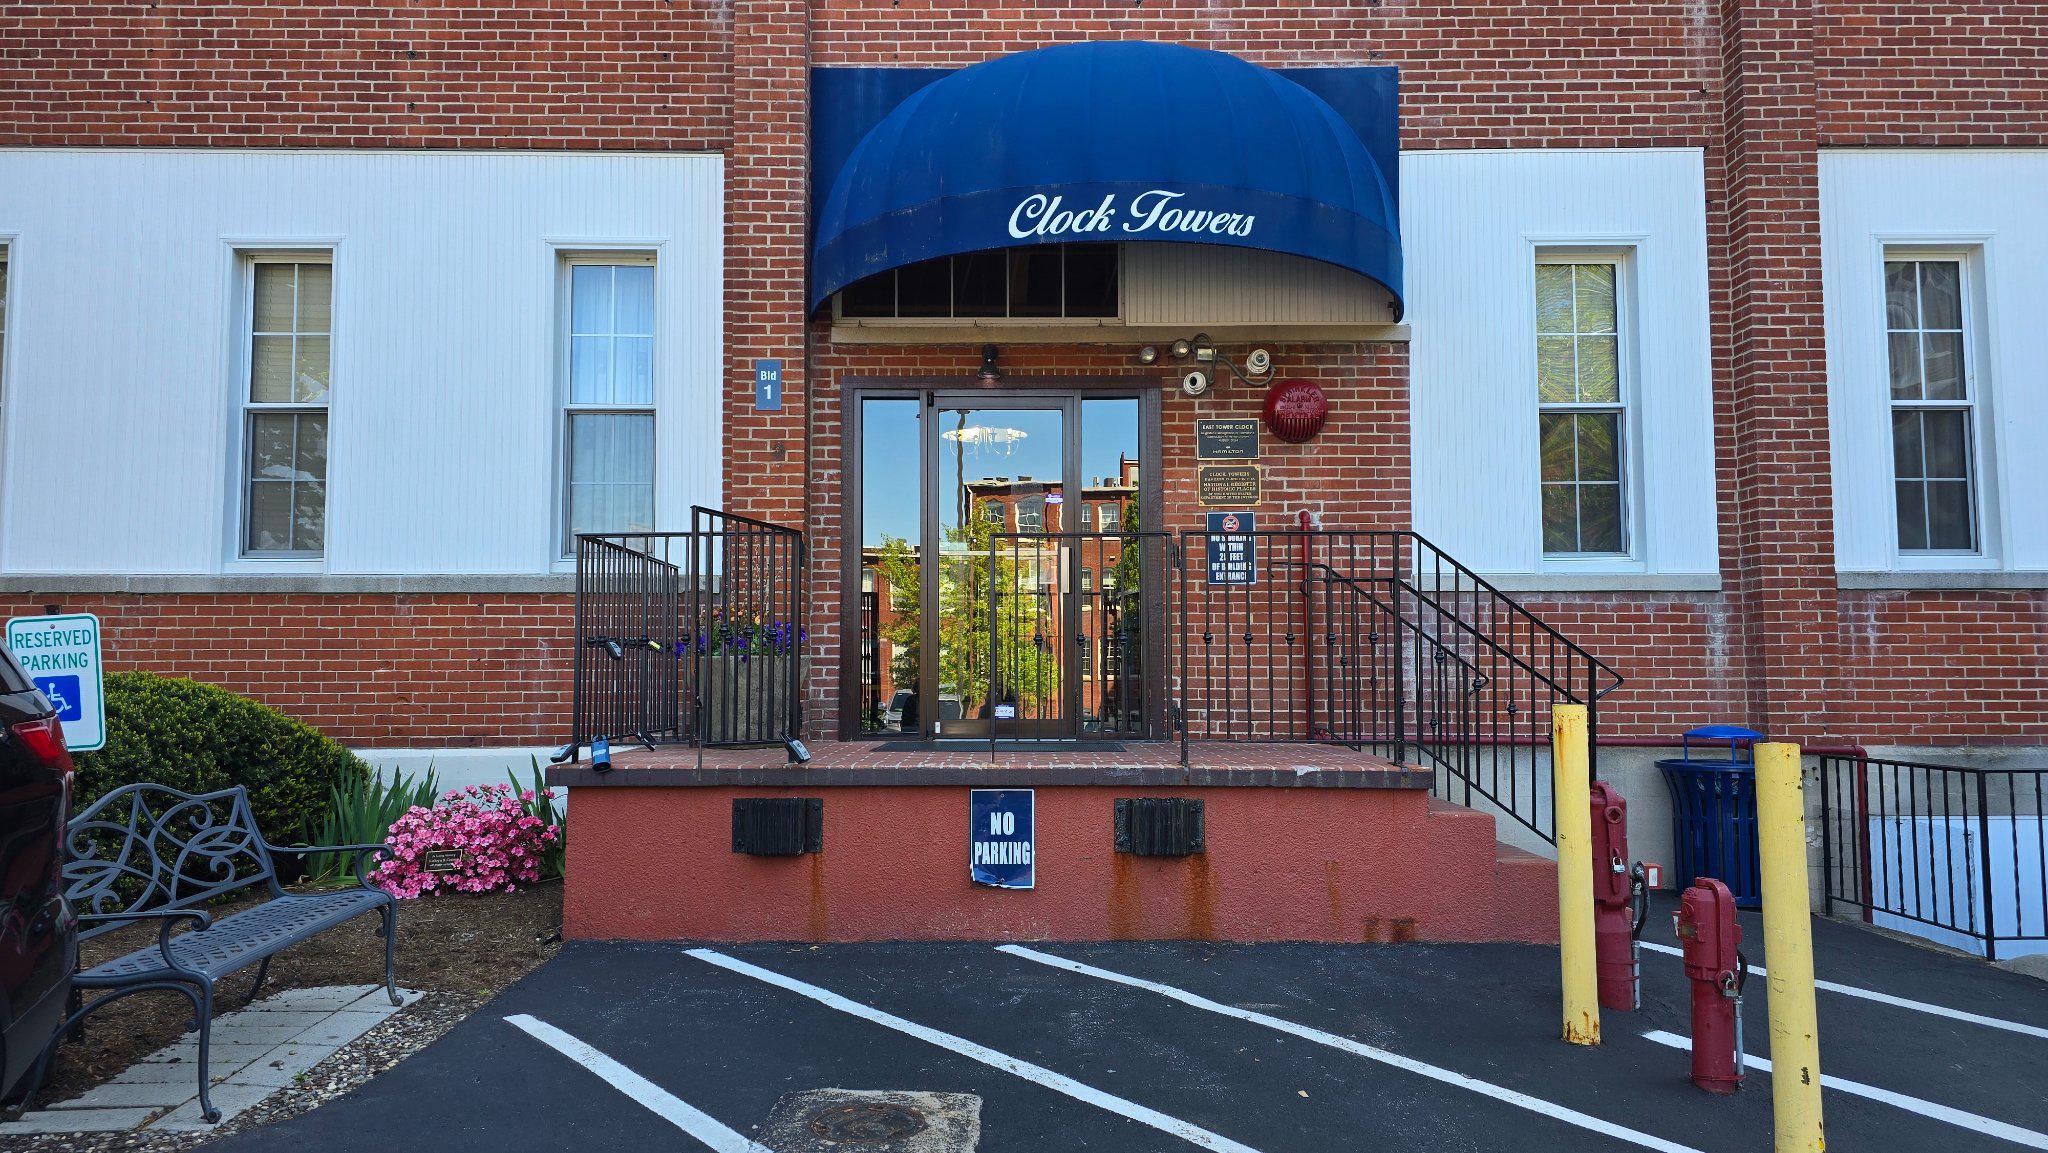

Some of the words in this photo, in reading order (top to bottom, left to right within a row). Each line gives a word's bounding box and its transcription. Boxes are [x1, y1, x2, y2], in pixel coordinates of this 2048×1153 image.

[1008, 193, 1116, 239] Clock
[1122, 189, 1256, 237] Towers
[760, 370, 777, 381] Bld
[763, 384, 772, 400] 1
[1219, 542, 1244, 552] WTHIN
[1229, 552, 1243, 561] FEET
[1211, 562, 1220, 571] OF
[14, 629, 92, 649] RESERVED
[21, 652, 89, 671] PARKING
[990, 811, 1015, 836] NO
[974, 840, 1031, 866] PARKING
